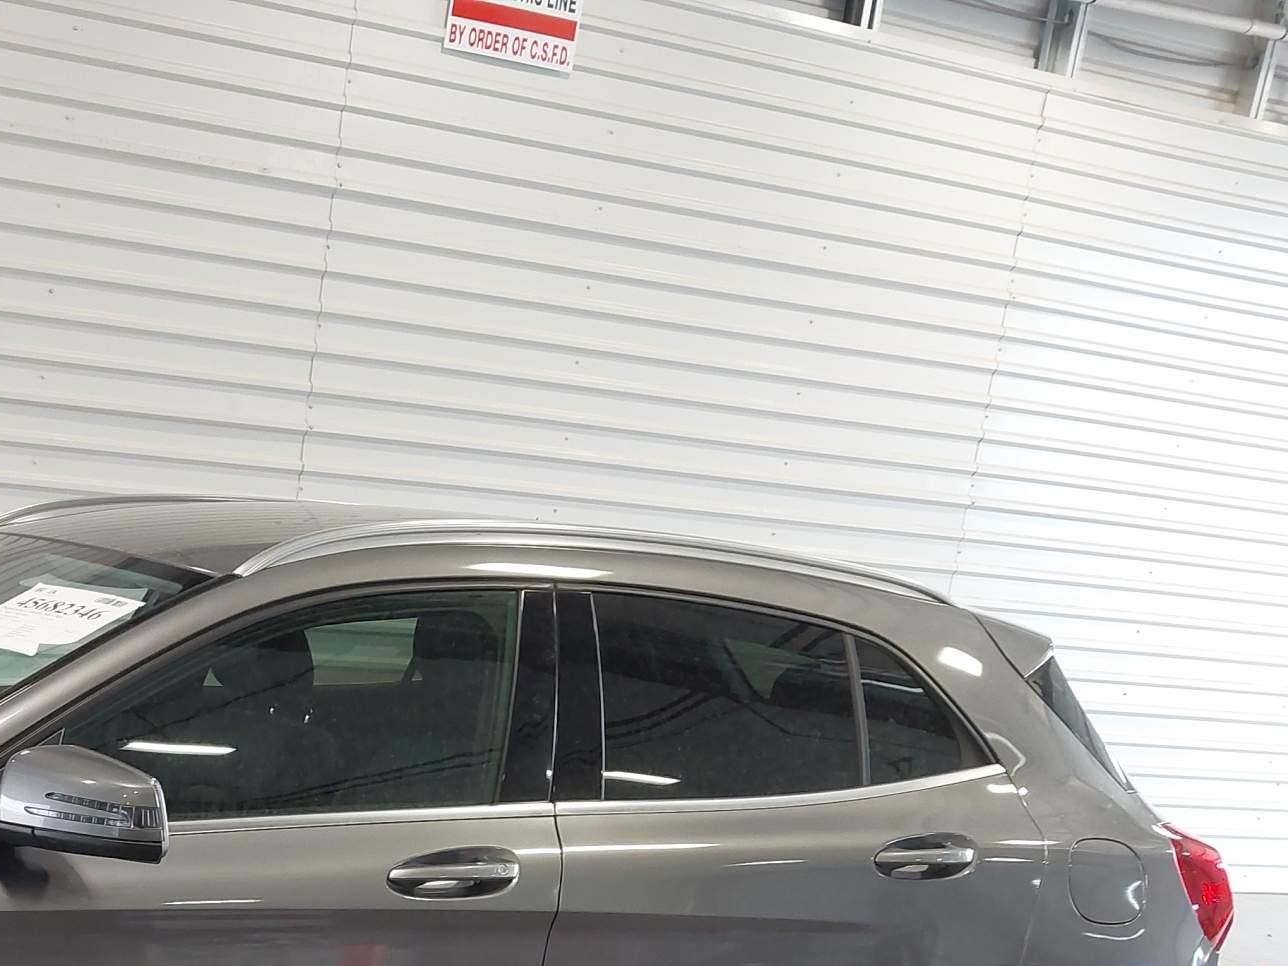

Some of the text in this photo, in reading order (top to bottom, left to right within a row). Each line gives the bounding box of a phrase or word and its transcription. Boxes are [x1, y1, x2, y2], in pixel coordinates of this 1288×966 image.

[448, 24, 571, 66] BY ORDER OF C.S.F.D.
[16, 595, 112, 620] 45682346
